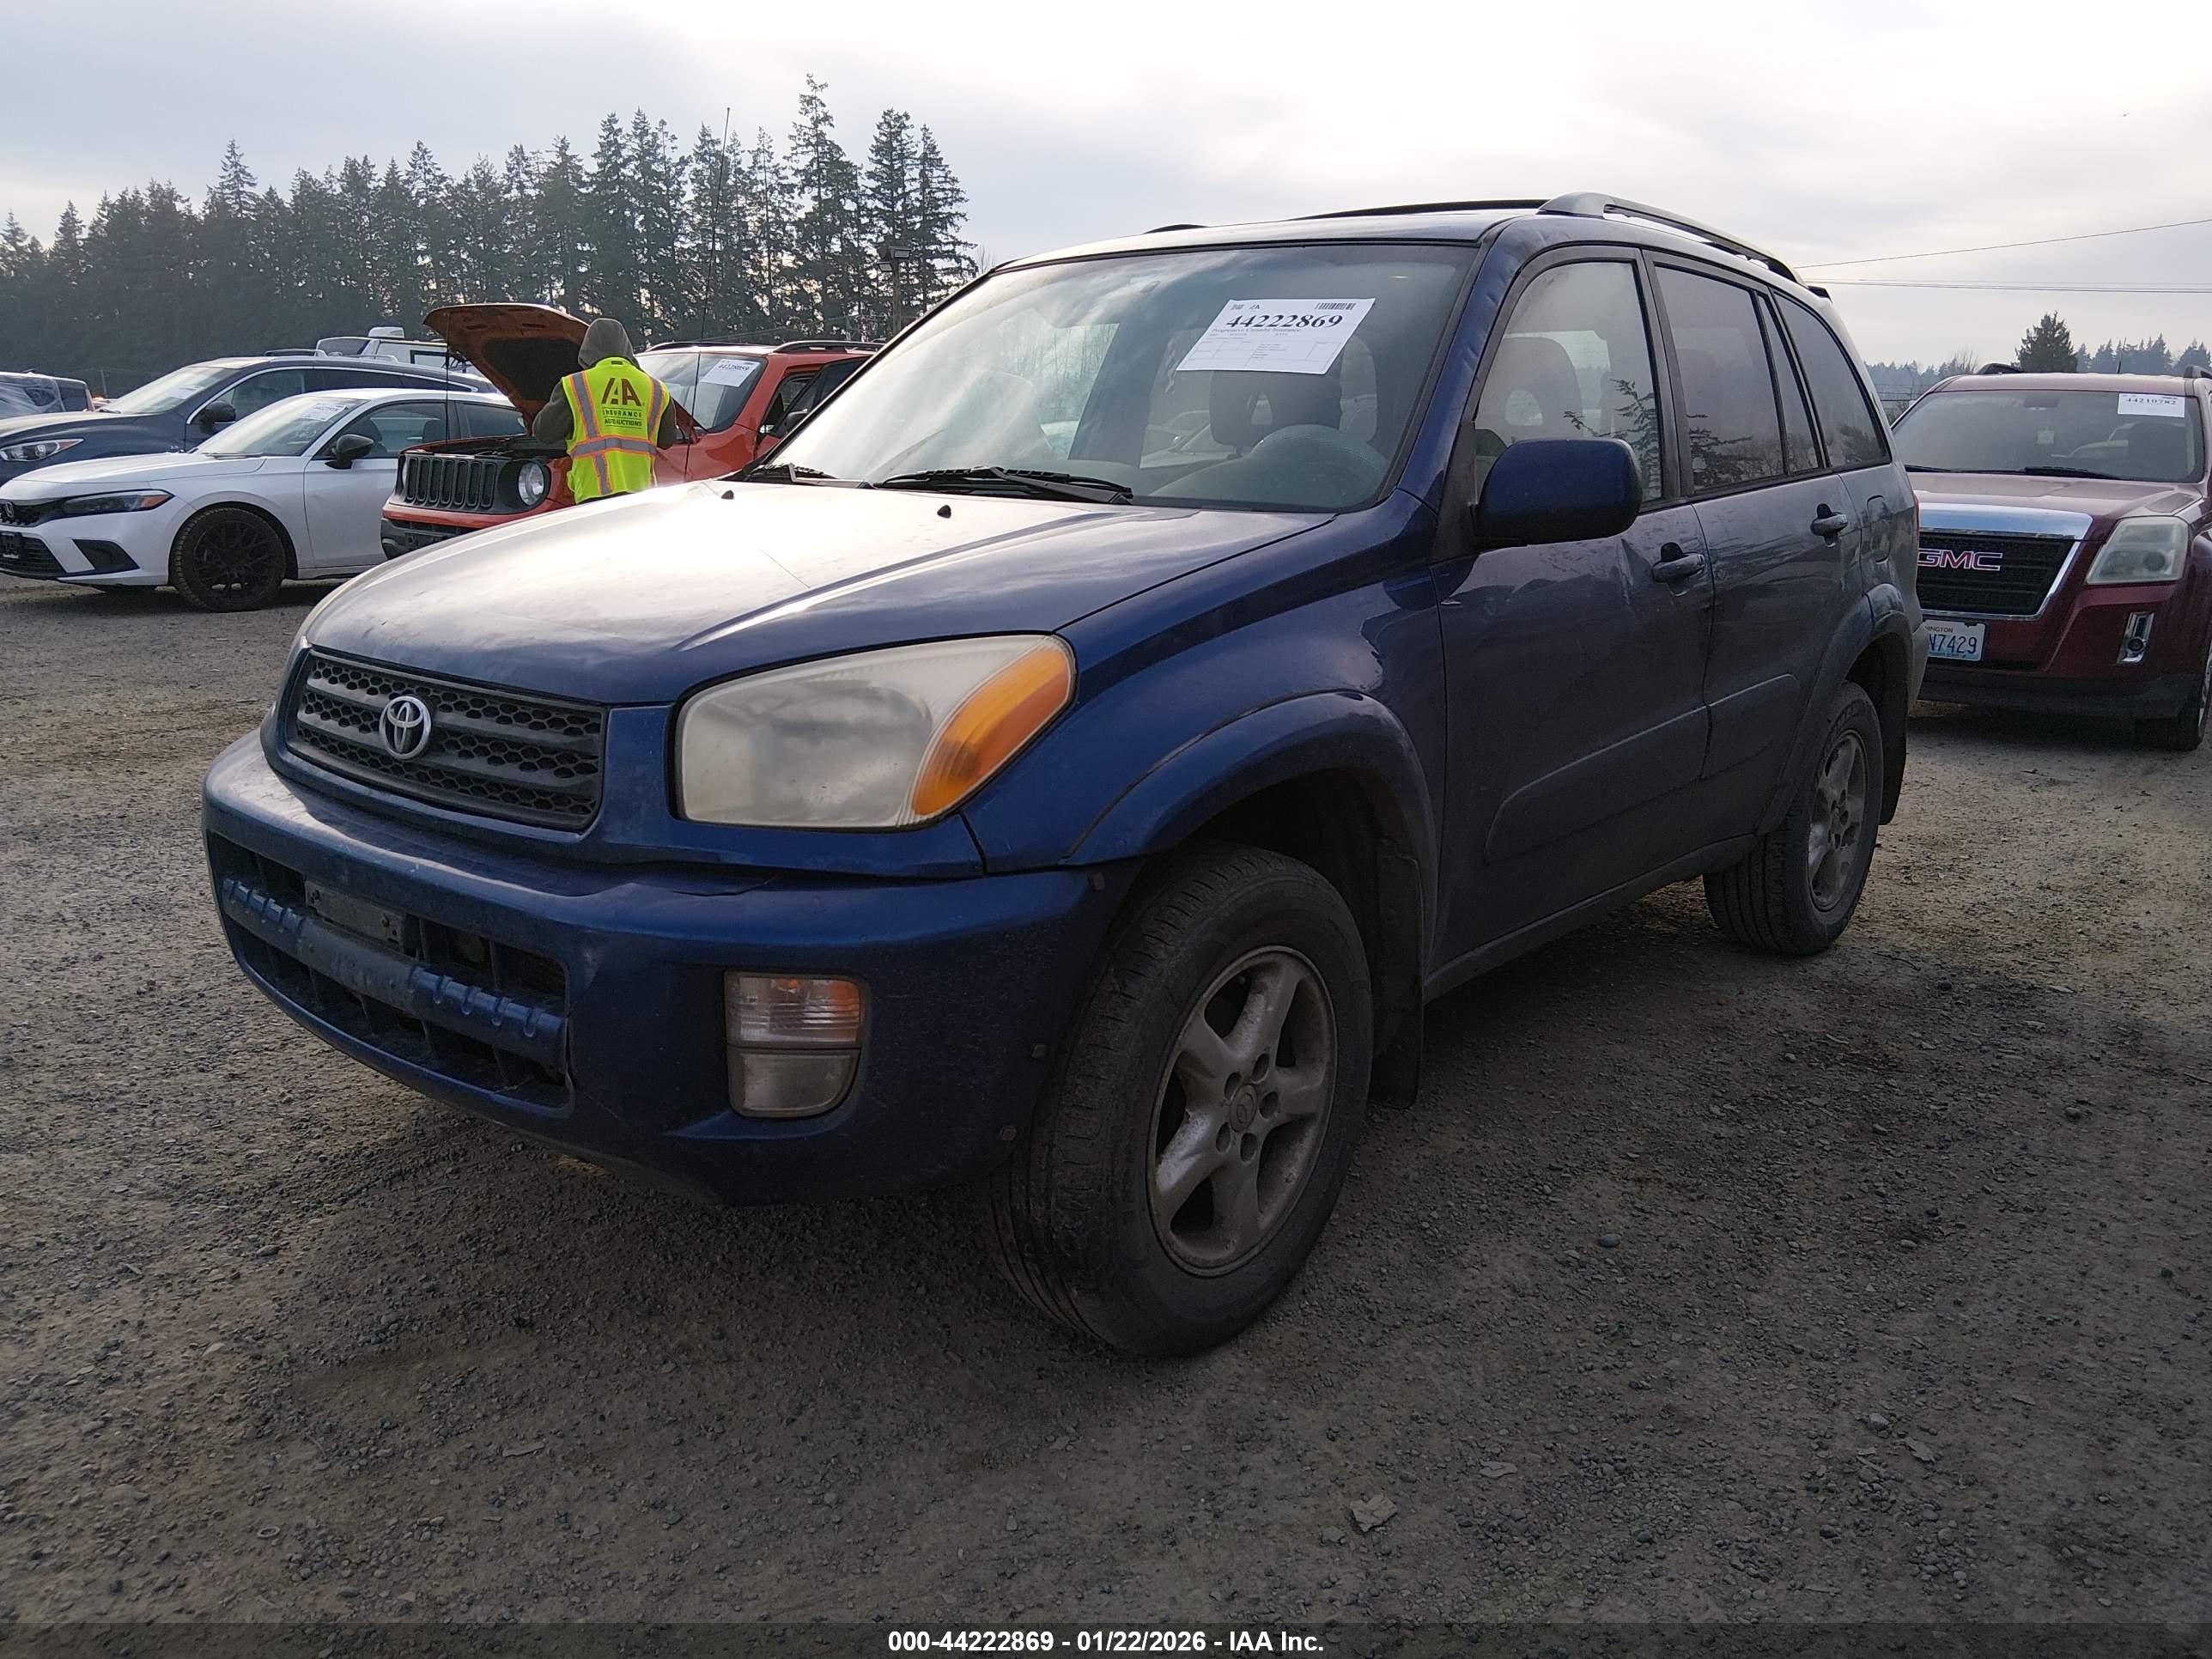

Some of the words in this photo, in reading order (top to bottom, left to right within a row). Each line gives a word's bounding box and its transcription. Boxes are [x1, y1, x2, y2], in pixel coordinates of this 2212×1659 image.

[1225, 314, 1344, 329] 44222869
[602, 410, 642, 418] INSURANCE
[1917, 548, 2002, 571] GMC
[1929, 633, 1978, 653] N7429
